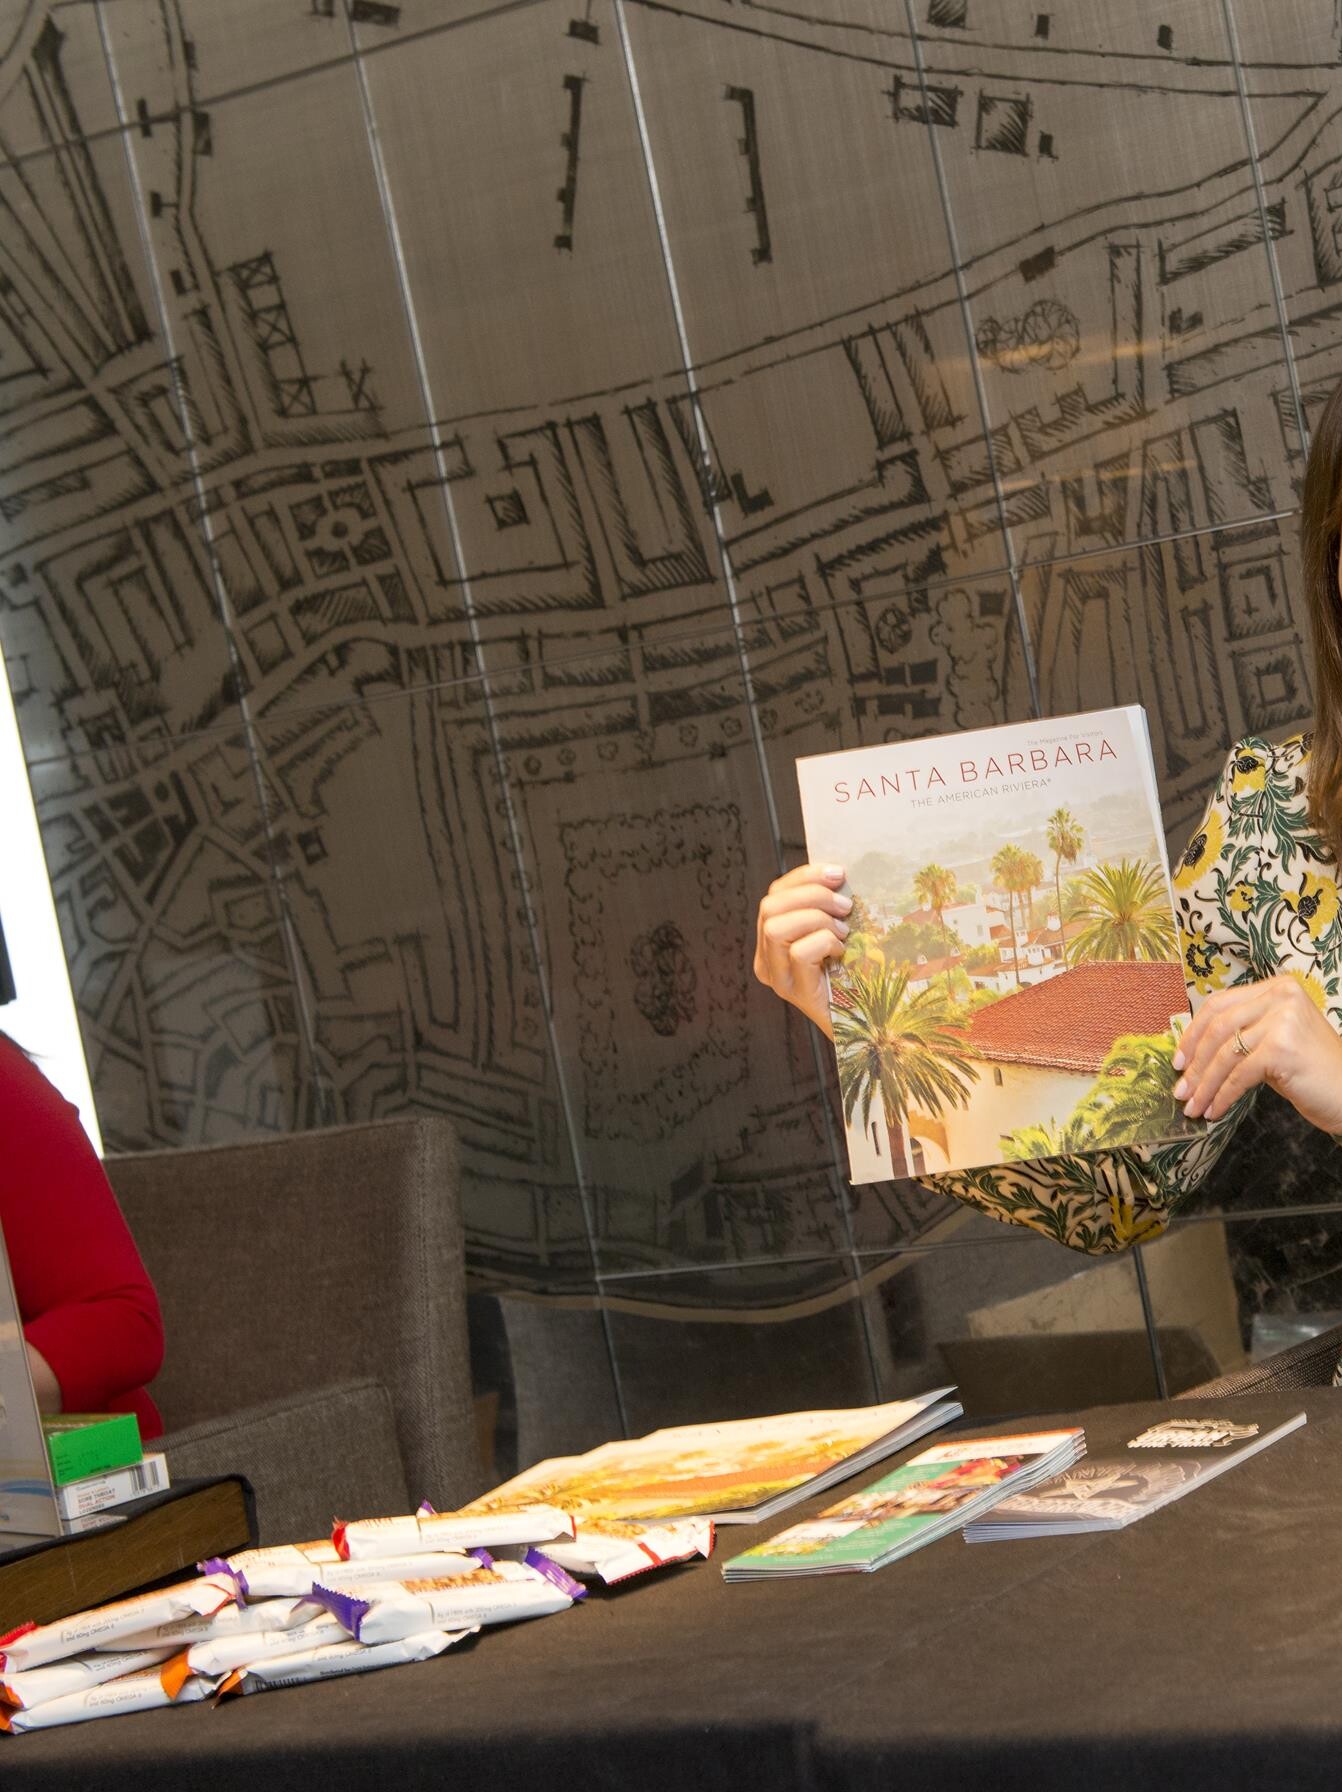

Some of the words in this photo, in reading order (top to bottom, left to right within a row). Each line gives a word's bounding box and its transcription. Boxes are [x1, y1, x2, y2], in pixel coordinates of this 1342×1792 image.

[834, 766, 946, 803] SANTA
[960, 739, 1118, 783] BARBARA
[911, 797, 935, 808] THE
[938, 785, 999, 804] AMERICAN
